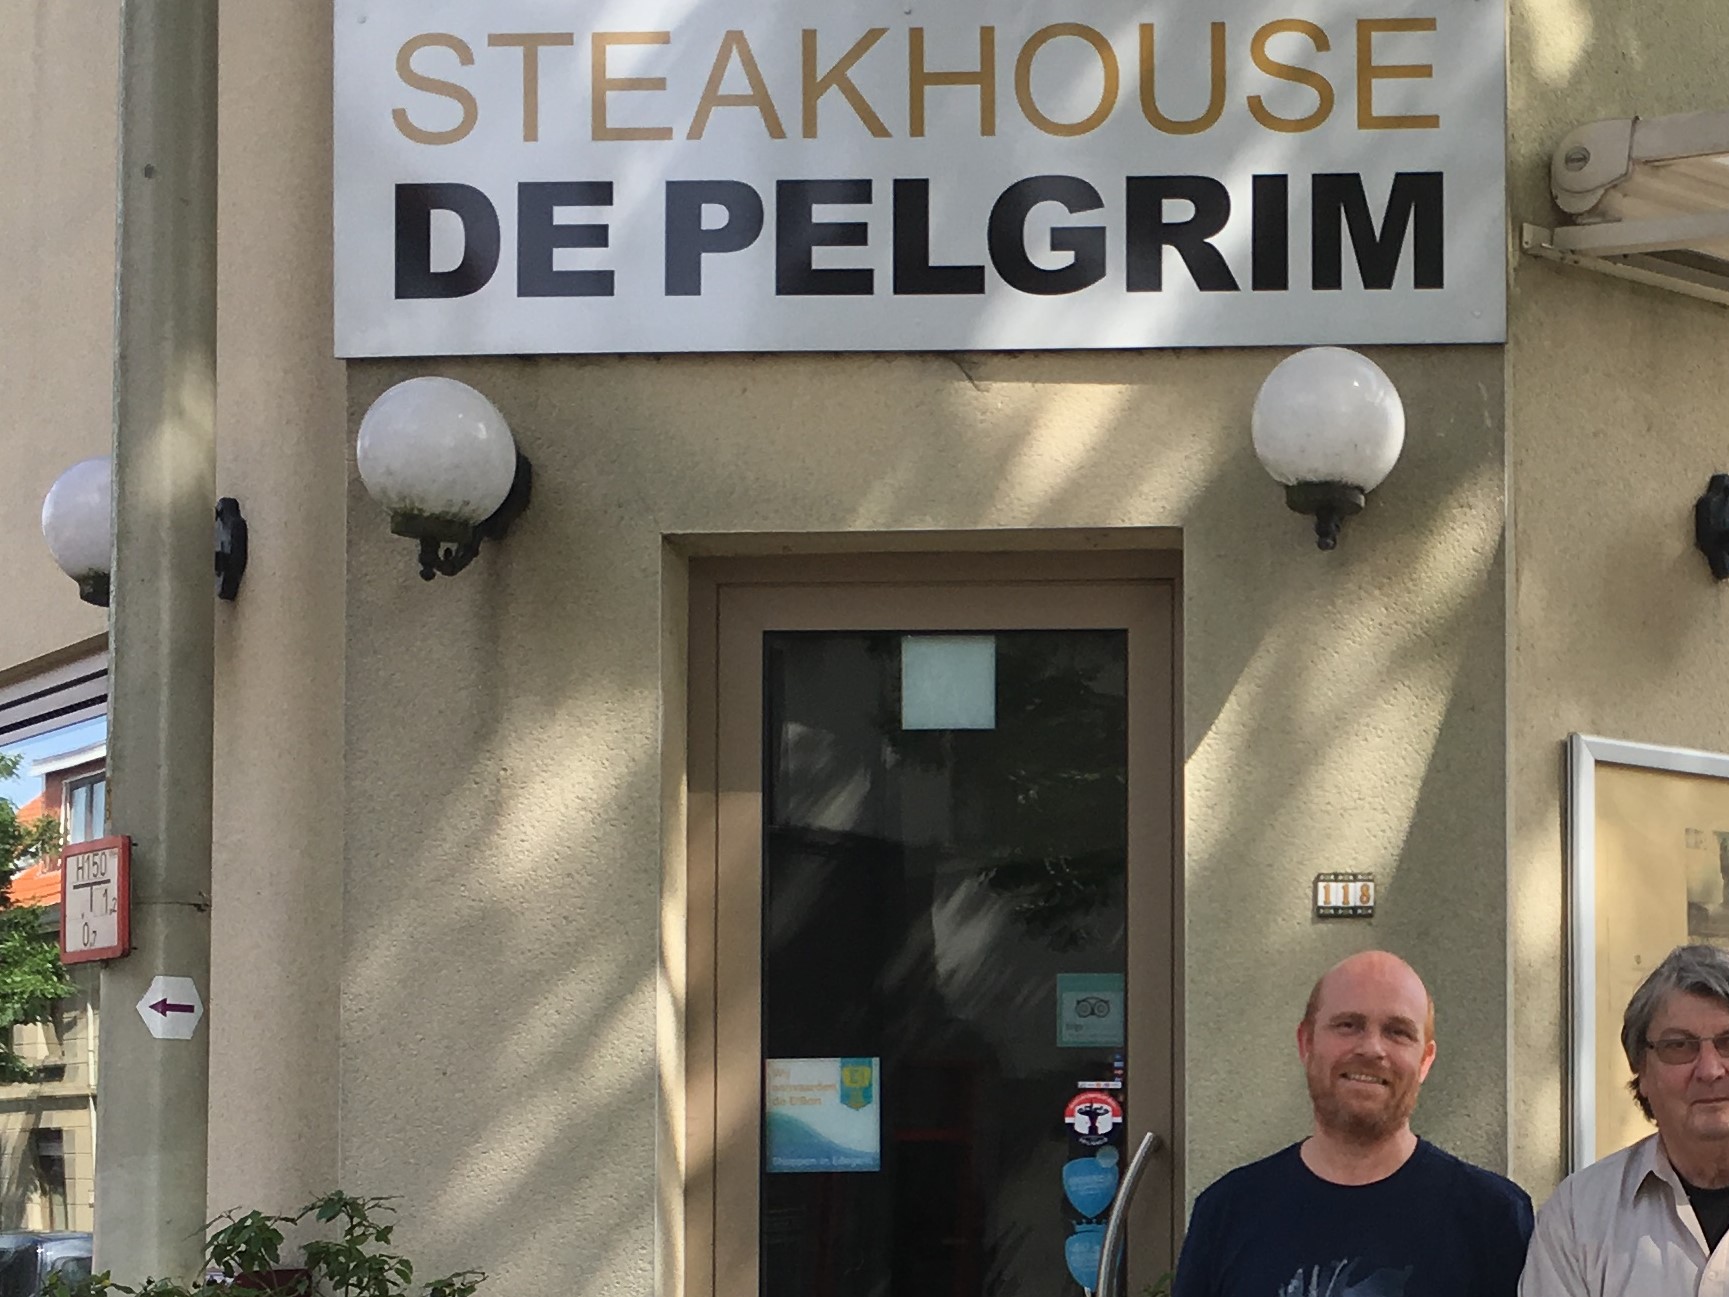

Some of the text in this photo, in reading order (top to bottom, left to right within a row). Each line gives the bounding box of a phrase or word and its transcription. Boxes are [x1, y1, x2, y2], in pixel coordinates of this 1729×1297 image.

[391, 17, 1440, 145] STEAKHOUSE
[394, 171, 1444, 299] DE PELGRIM
[76, 851, 107, 881] H150
